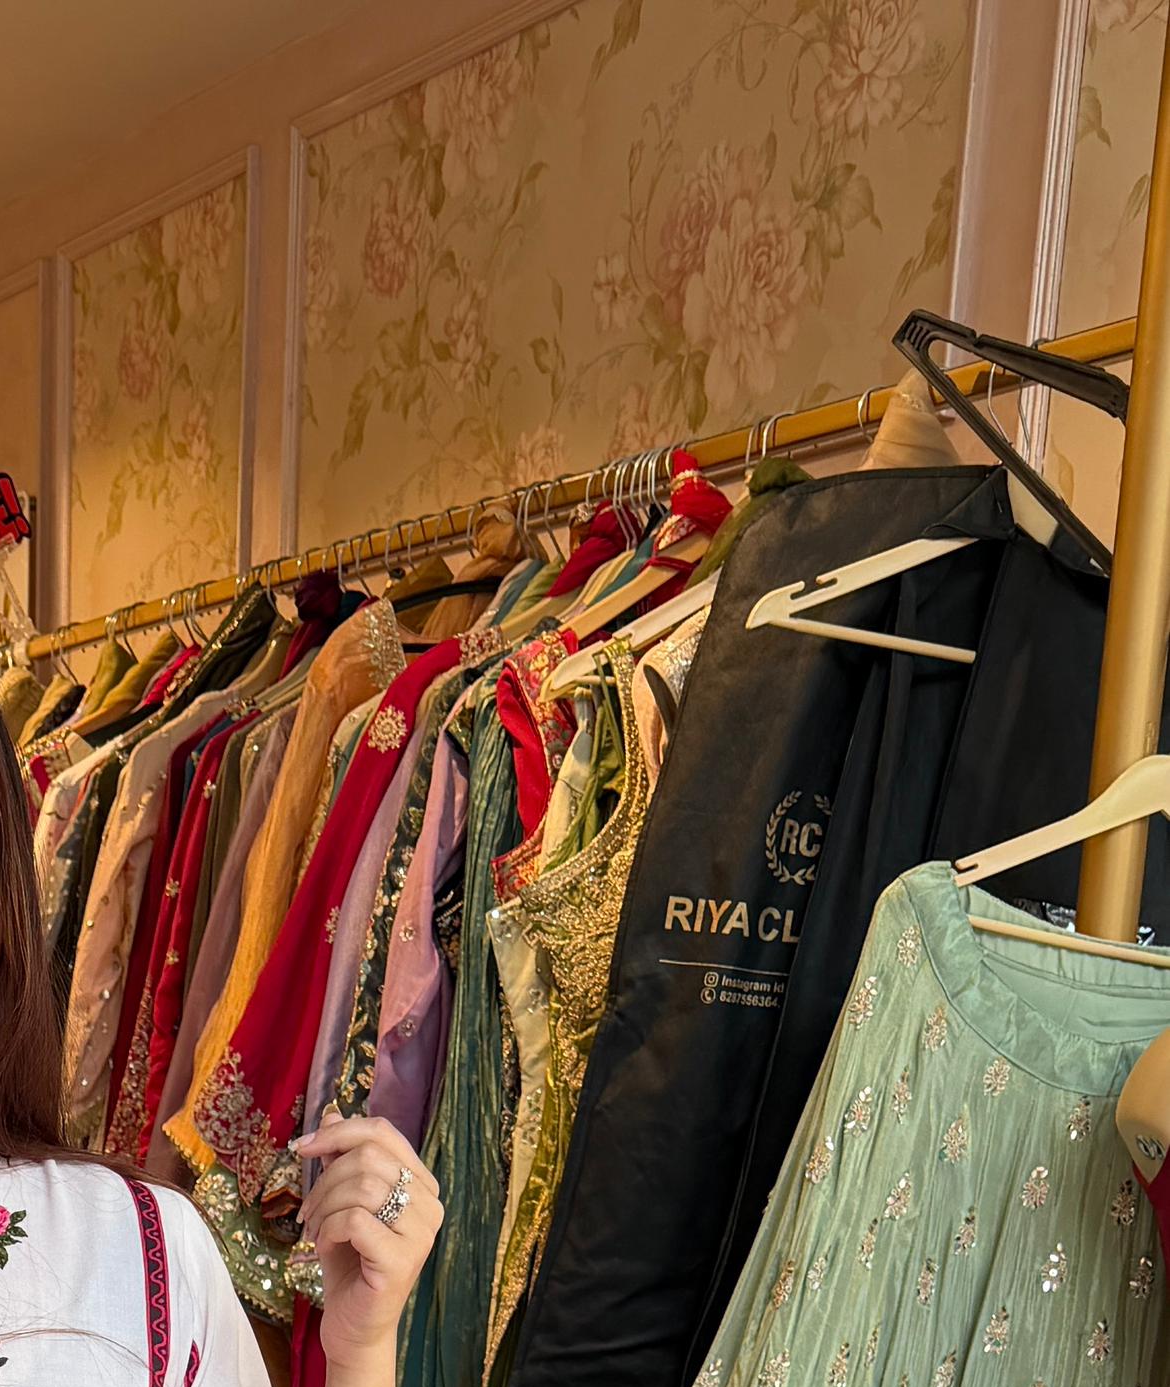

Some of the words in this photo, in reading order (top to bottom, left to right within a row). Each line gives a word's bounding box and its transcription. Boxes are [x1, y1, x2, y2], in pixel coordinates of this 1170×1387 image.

[780, 818, 823, 858] RC
[664, 895, 750, 938] RIYA
[757, 906, 800, 943] CL
[721, 974, 771, 993] Instagram
